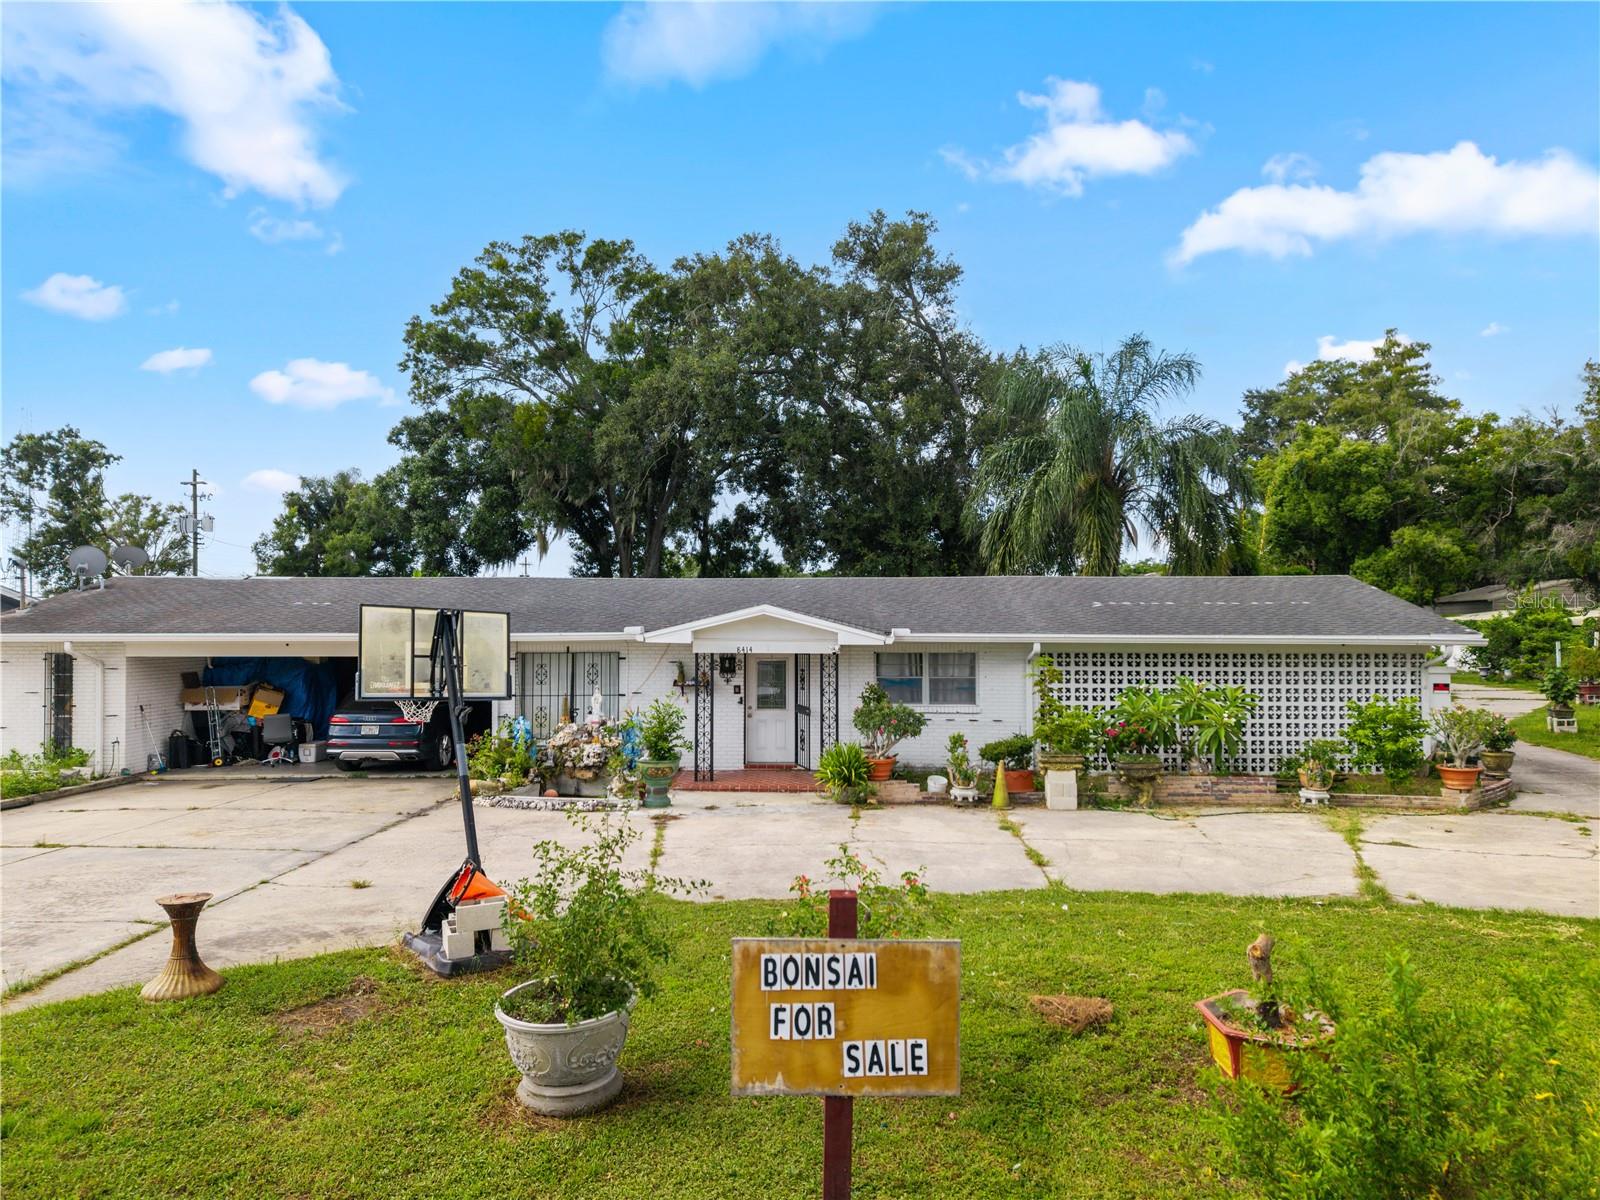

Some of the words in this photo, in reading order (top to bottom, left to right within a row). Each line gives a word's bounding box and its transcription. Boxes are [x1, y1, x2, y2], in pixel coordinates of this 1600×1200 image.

[763, 956, 875, 988] BONSAI
[773, 1005, 832, 1037] FOR
[846, 1043, 924, 1074] SALE
